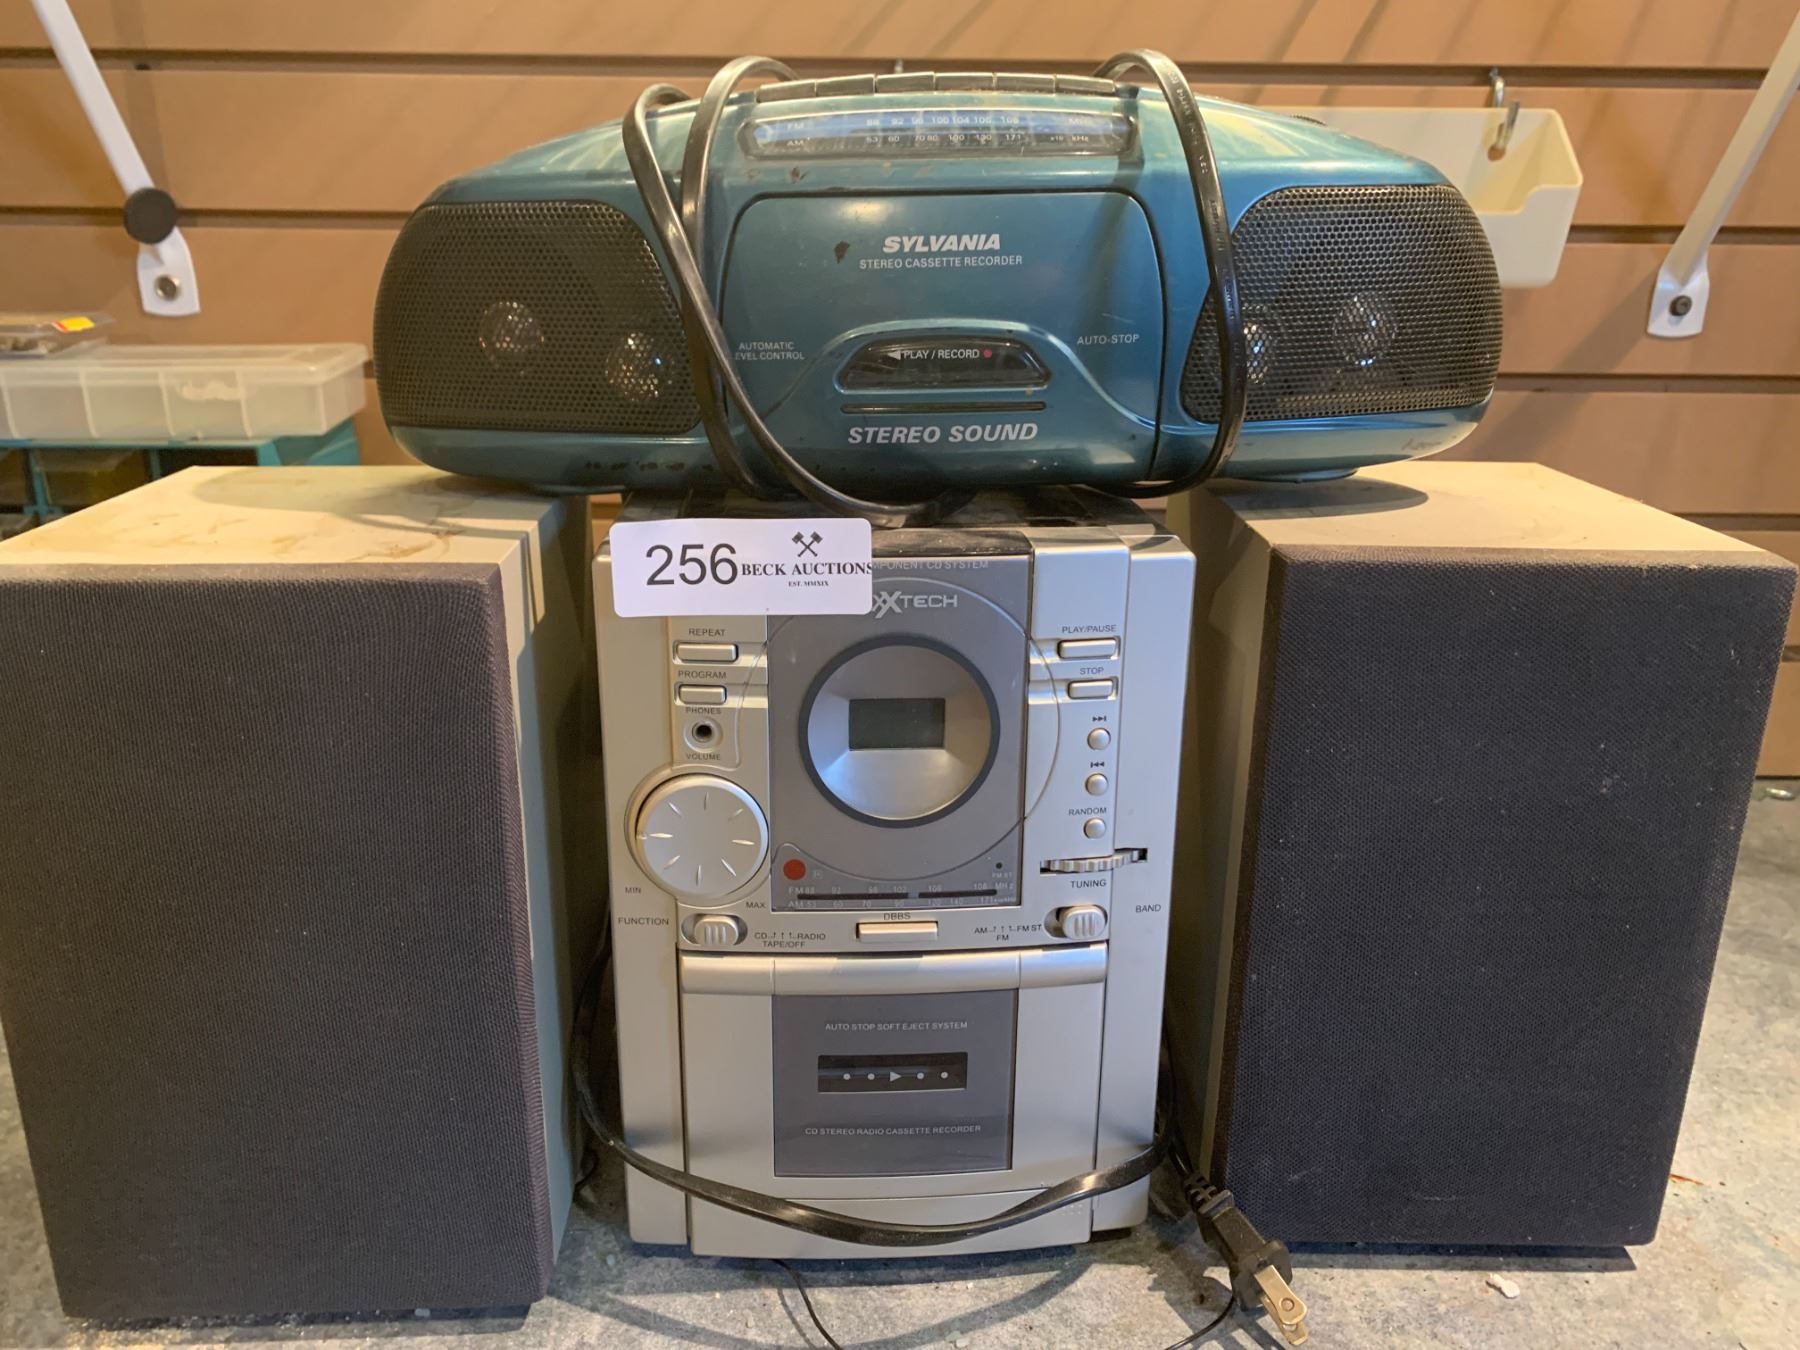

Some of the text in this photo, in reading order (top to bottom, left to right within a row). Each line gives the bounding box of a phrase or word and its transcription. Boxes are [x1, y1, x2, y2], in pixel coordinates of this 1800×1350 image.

[931, 116, 950, 125] 100
[952, 116, 970, 124] 104
[882, 233, 1000, 253] SYLVANIA
[859, 255, 1023, 269] STEREO CASSETTE RECORDER
[1077, 333, 1140, 346] AUTO-STOP
[738, 341, 795, 350] AUTOMATIC
[735, 351, 805, 360] EVEL CONTROL
[903, 350, 929, 359] PLAY
[938, 349, 980, 359] RECORD
[848, 423, 1038, 444] STEREO SOUND
[646, 543, 738, 586] 256
[741, 561, 872, 576] BECK AUCTIONS
[872, 560, 989, 570] MPONENT CD SYSTEM
[688, 628, 725, 637] REPEAT
[1062, 624, 1117, 634] PLAY/PAUSE
[678, 670, 727, 679] PROGRAM
[1079, 667, 1104, 675] STOP
[685, 707, 722, 715] PHONES
[685, 753, 721, 761] VOLUME
[1068, 807, 1107, 816] RANDOM
[1071, 879, 1107, 889] TUNING
[746, 901, 766, 909] MAX
[1135, 904, 1162, 914] BAND
[883, 912, 911, 920] DBBS
[618, 917, 669, 925] FUNCTION
[763, 940, 806, 948] TAPE/OFF
[826, 1023, 849, 1031] AUTO
[851, 1023, 875, 1031] STOP
[877, 1023, 900, 1031] SOFT
[903, 1022, 930, 1030] EJECT
[886, 1127, 930, 1135] CASSETTE
[933, 1125, 981, 1134] RECORDER
